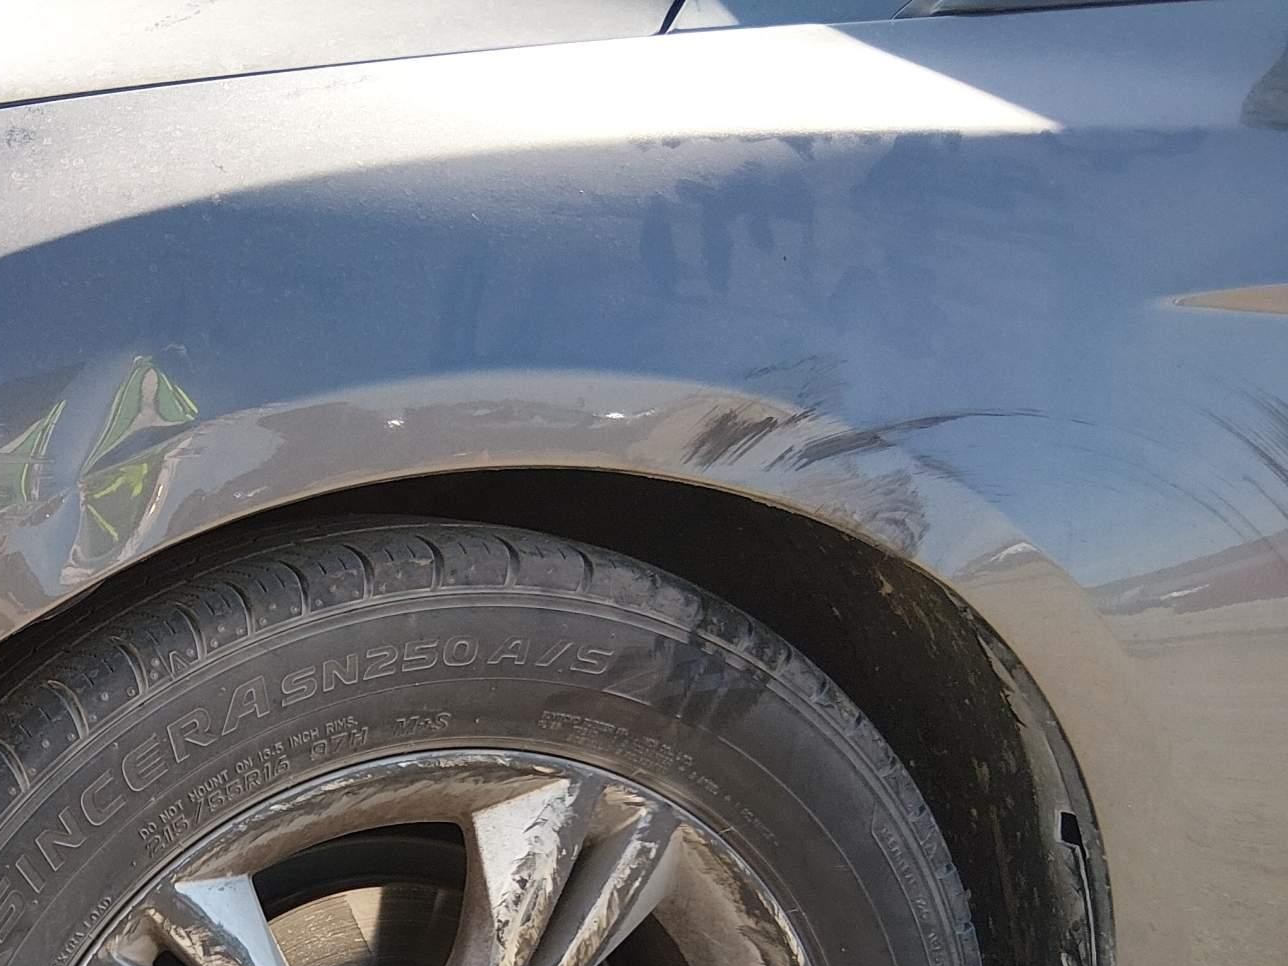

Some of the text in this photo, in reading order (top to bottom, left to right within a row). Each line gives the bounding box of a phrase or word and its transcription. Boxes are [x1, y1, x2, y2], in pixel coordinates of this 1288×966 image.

[280, 635, 480, 708] SN250
[486, 637, 615, 675] A/S
[138, 822, 158, 842] DO
[158, 799, 184, 823] NOT
[187, 768, 230, 802] MOUNT
[234, 756, 254, 774] ON
[288, 727, 320, 749] INCH
